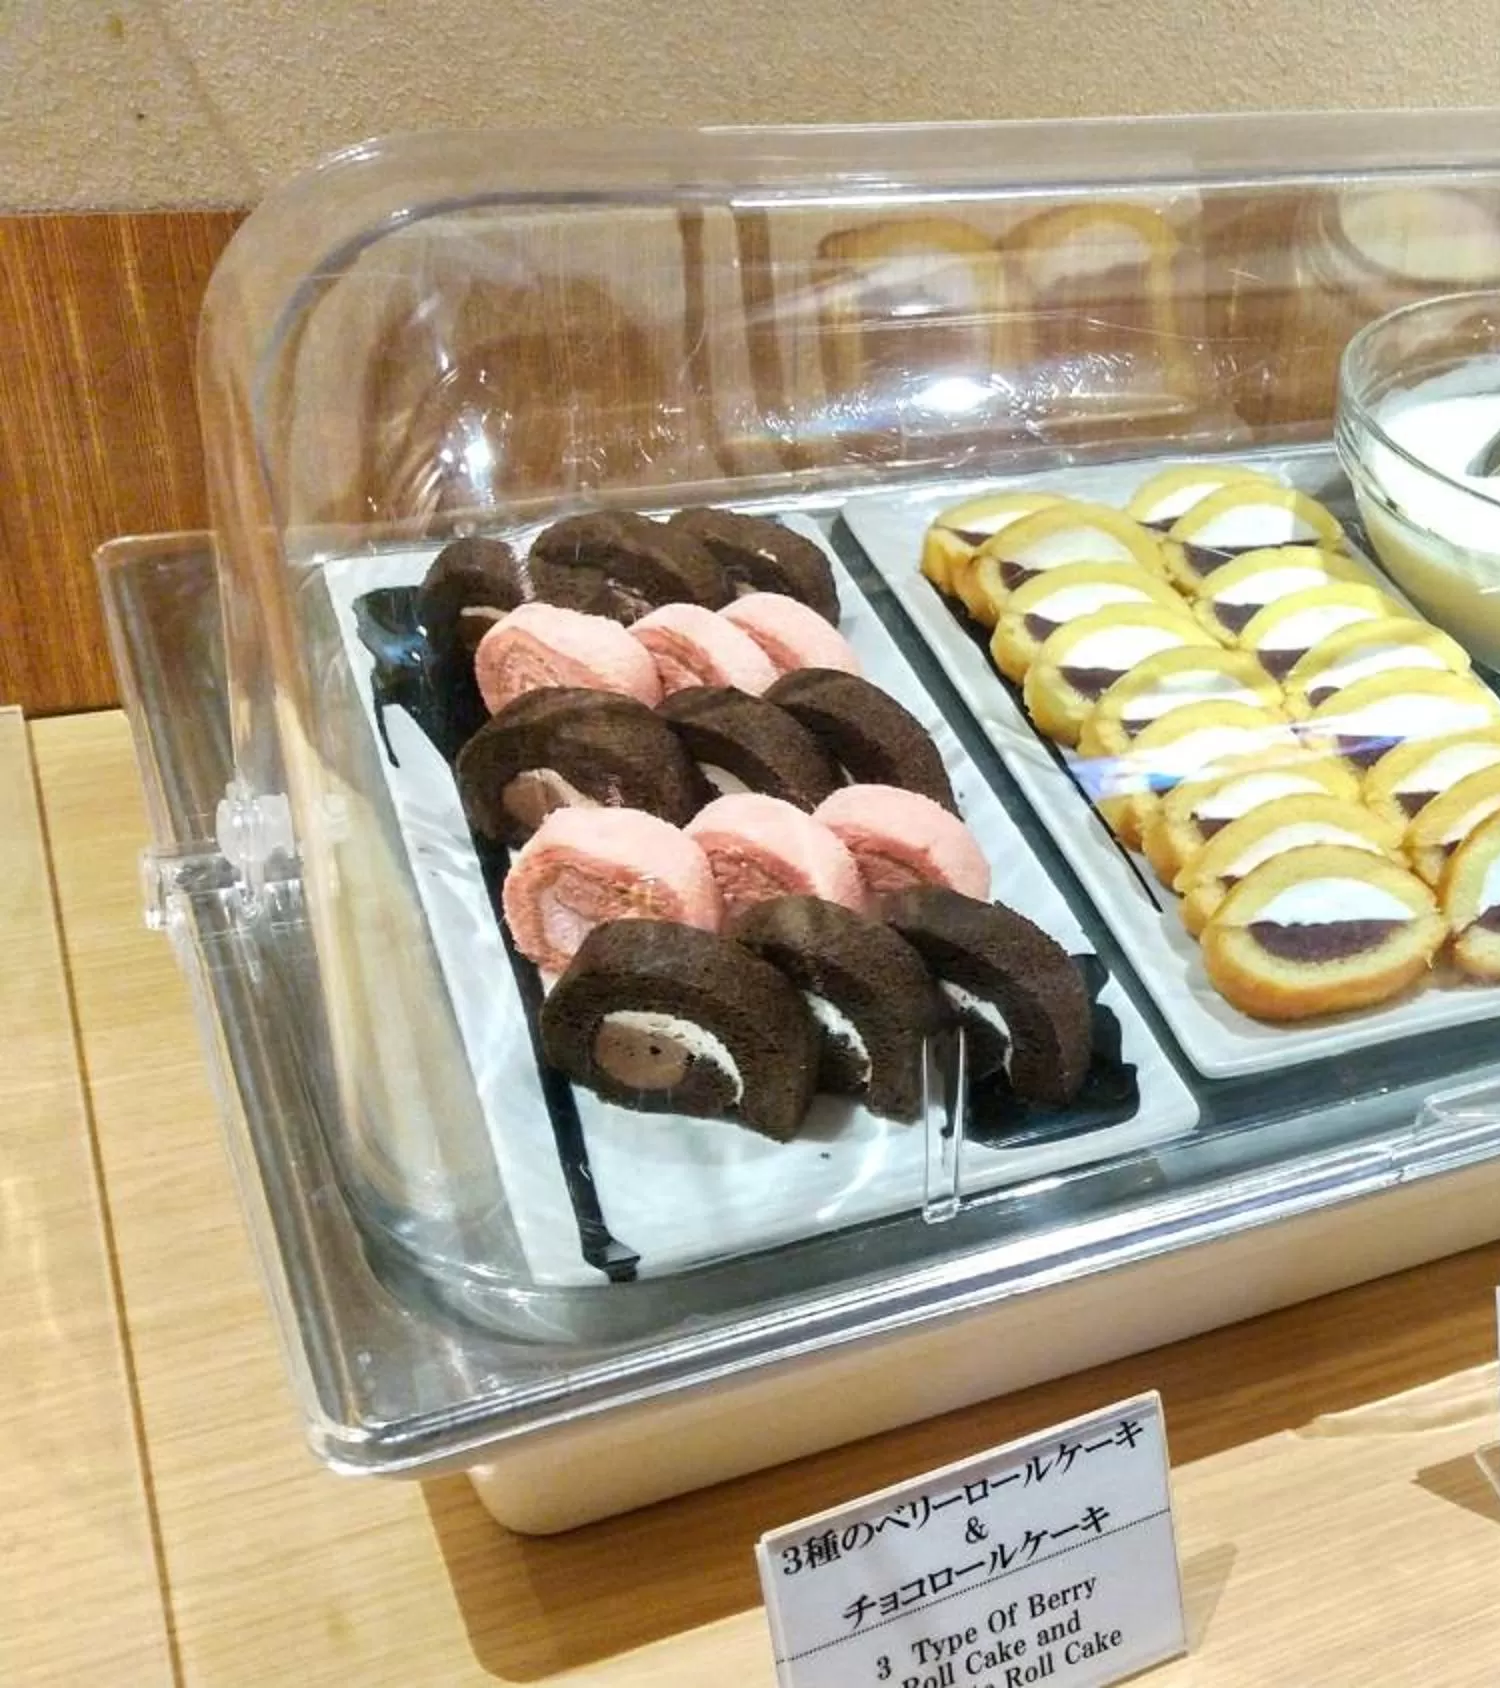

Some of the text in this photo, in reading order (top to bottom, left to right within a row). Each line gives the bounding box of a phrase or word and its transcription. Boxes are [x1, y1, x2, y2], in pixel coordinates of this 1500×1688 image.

[781, 1420, 1144, 1576] 3種のベリーロールケーキ
[965, 1517, 989, 1544] &
[843, 1505, 1111, 1629] チョコロールケーキ
[876, 1577, 1097, 1680] 3 Type Of Berry
[966, 1639, 1027, 1675] Cake
[1037, 1610, 1082, 1647] and
[1005, 1629, 1123, 1688] Roll Cake
